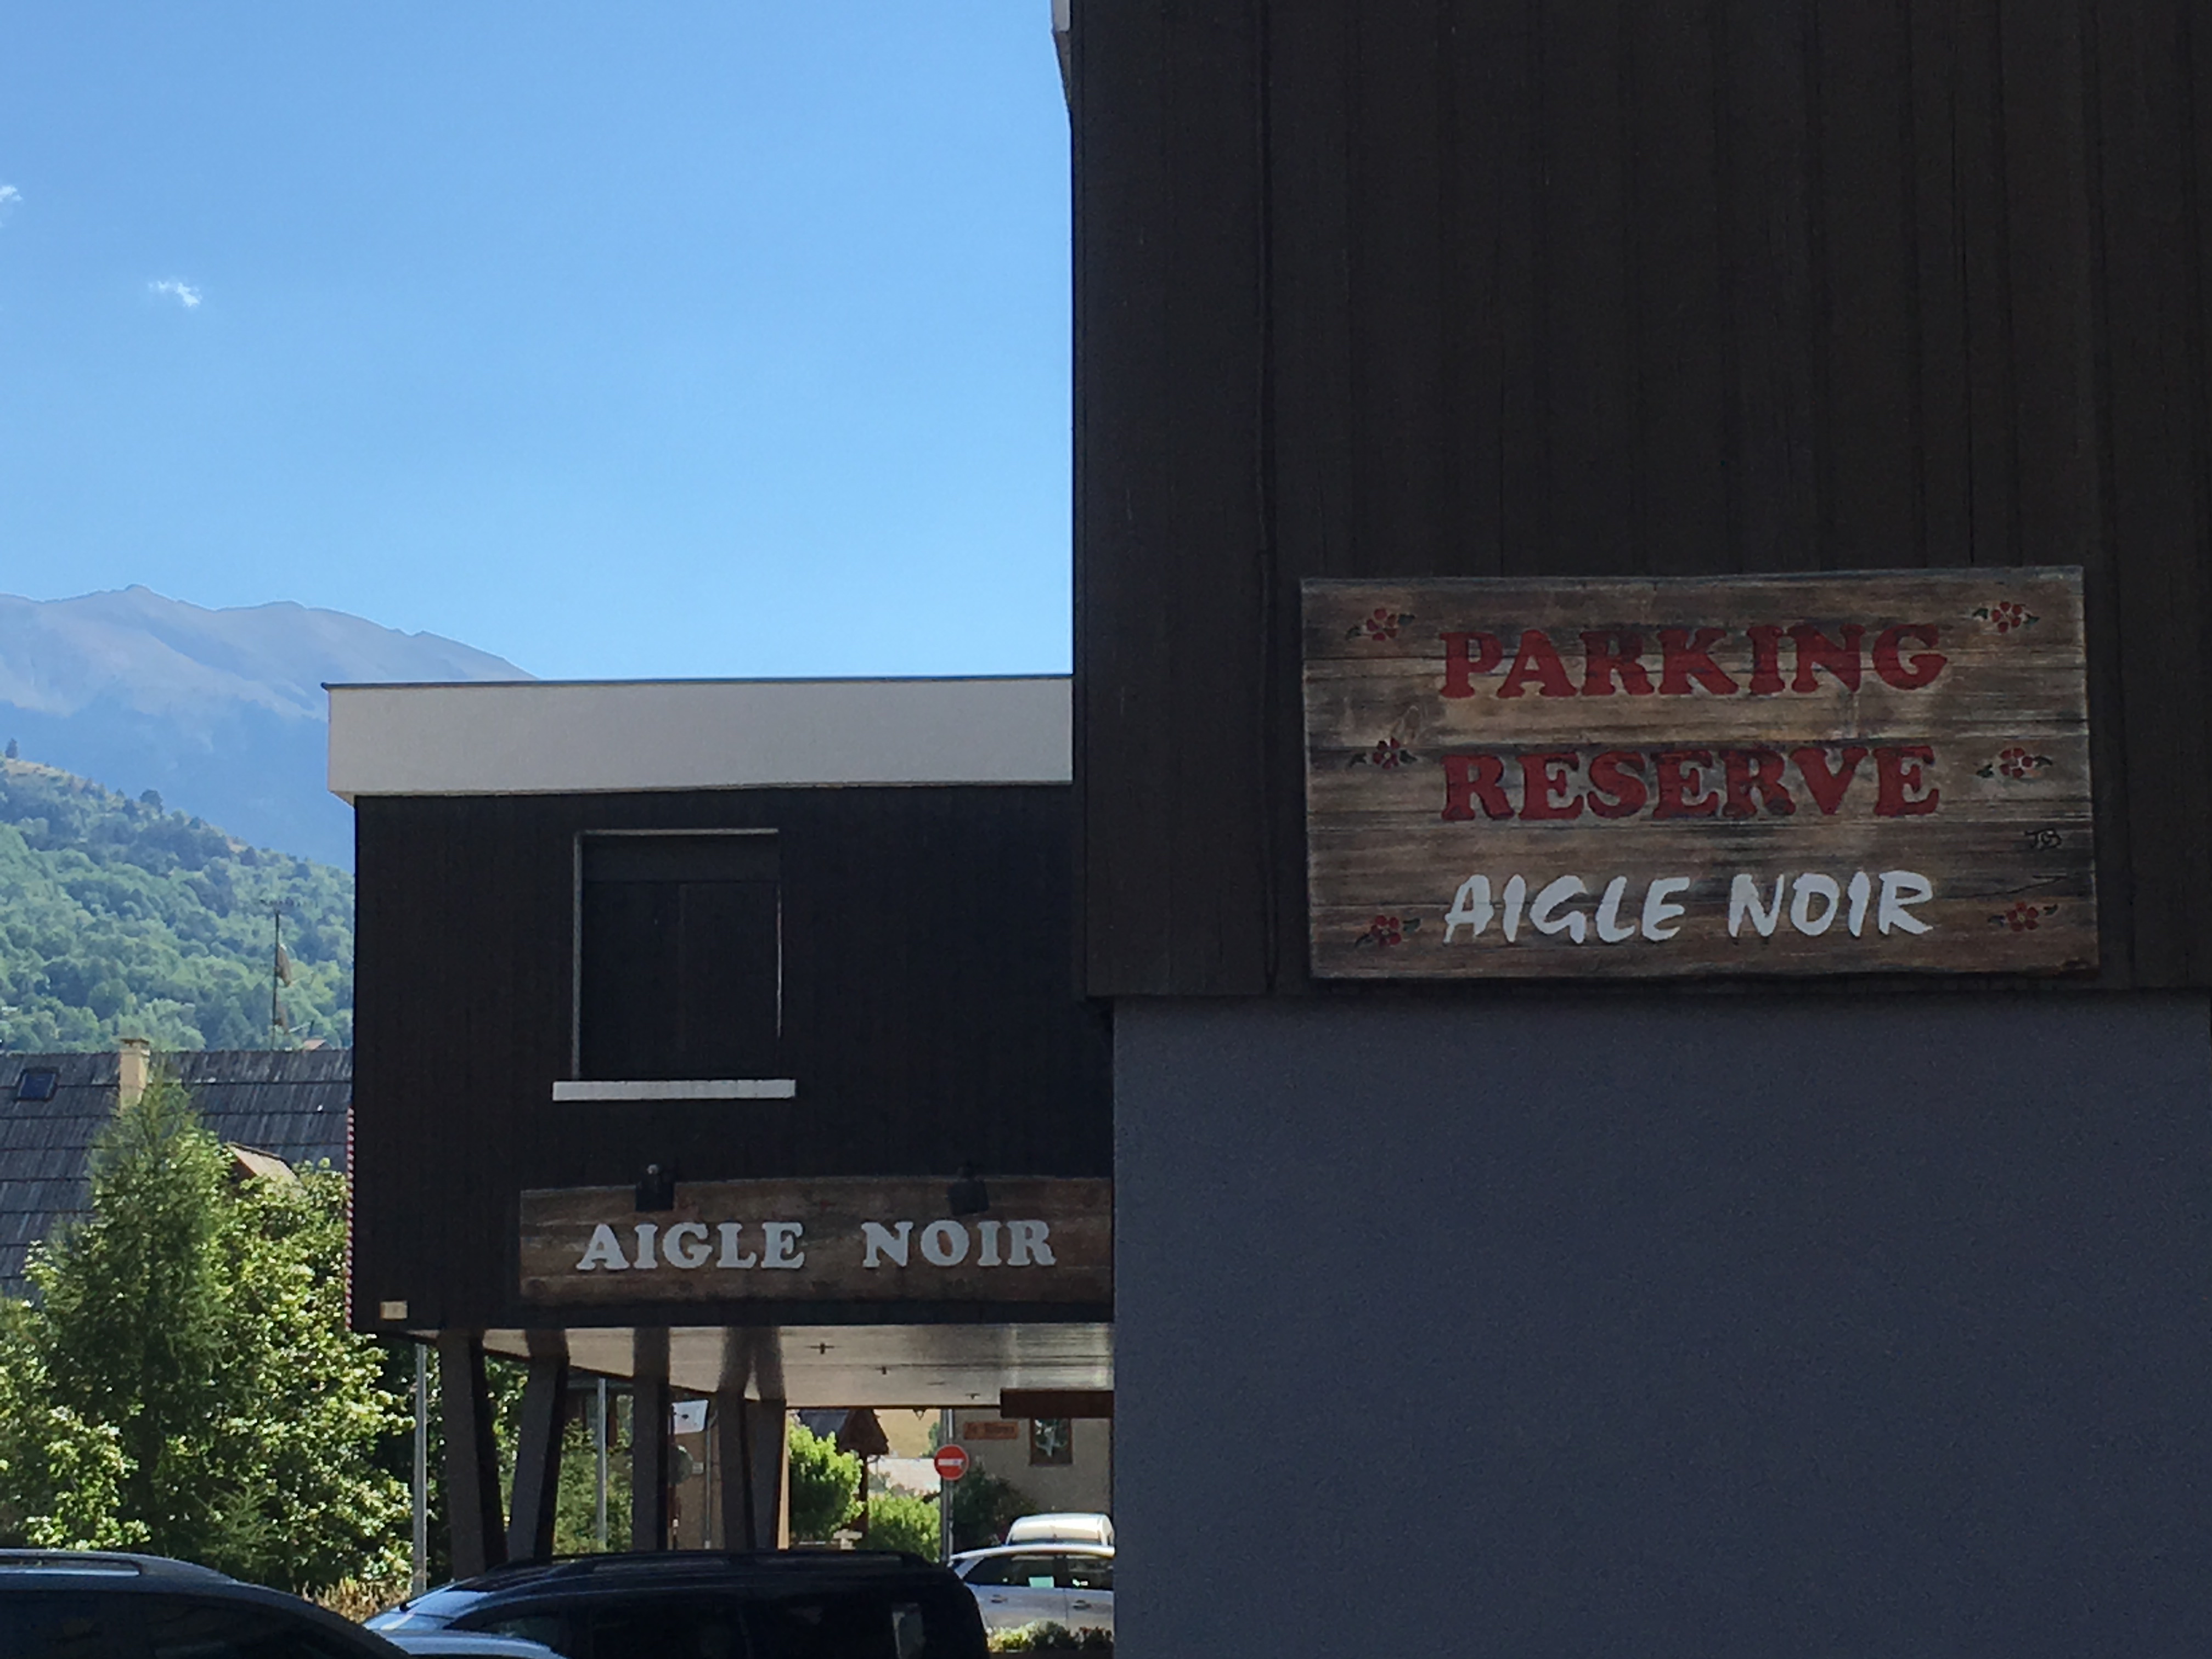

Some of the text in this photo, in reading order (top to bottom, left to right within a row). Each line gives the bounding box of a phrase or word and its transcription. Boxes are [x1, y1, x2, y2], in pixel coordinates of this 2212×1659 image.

[1438, 624, 1948, 699] PARKING
[1440, 745, 1939, 821] RESERVE
[1443, 870, 1934, 944] AIGLE NOIR
[575, 1219, 1056, 1271] AIGLE NOIR
